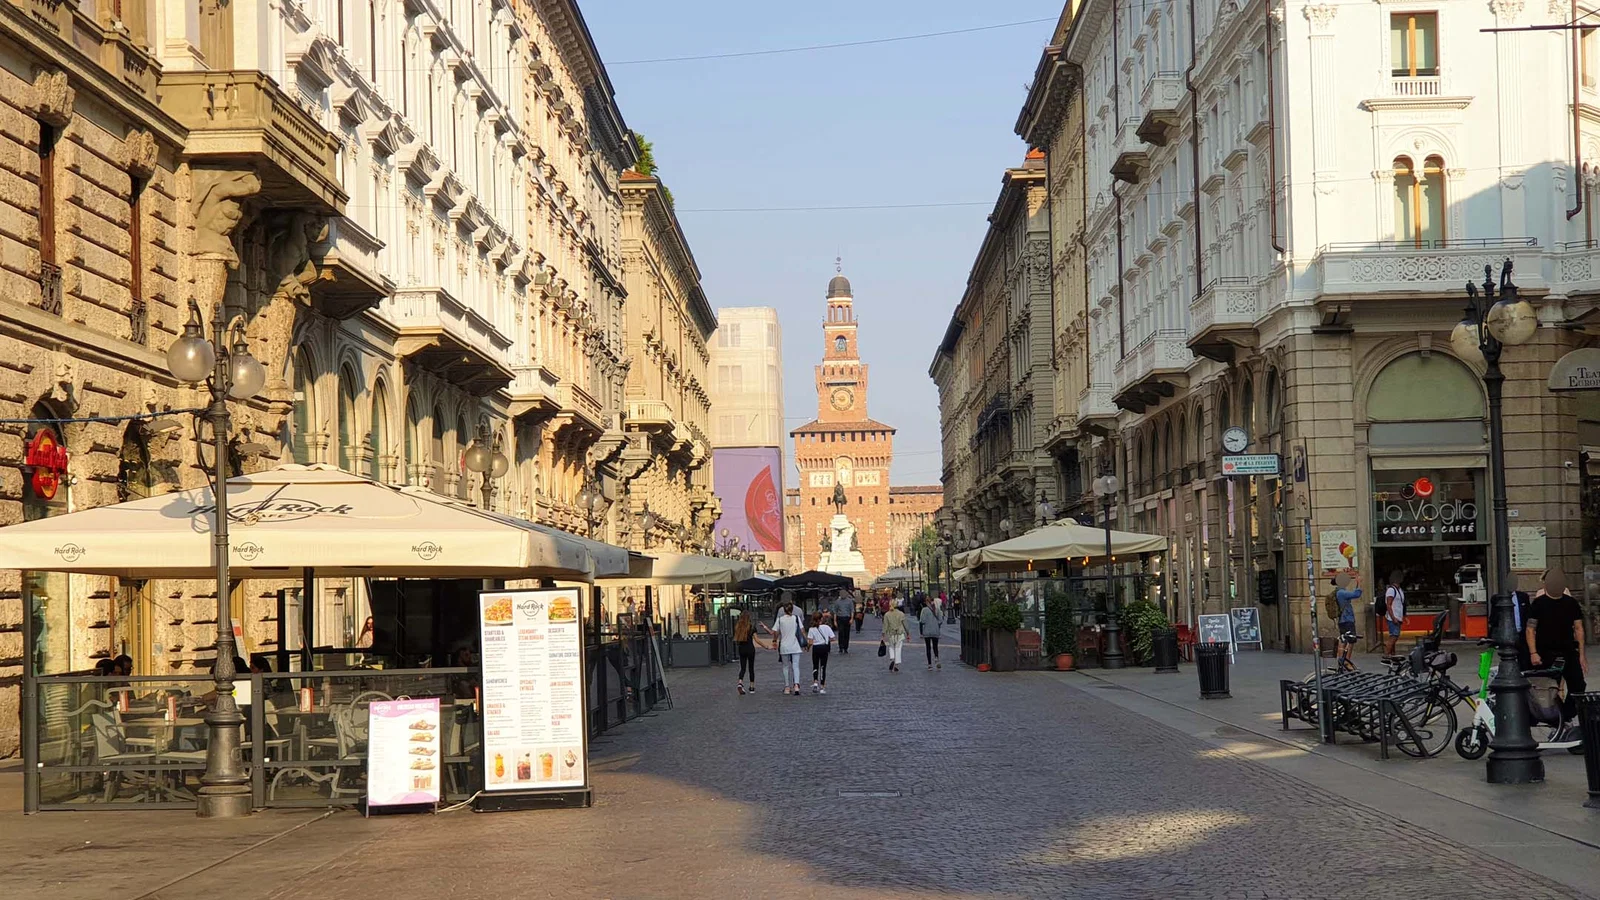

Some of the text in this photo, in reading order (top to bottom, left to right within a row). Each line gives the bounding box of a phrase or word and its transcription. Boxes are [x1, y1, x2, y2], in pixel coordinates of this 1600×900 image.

[187, 503, 353, 515] Hrd Rock
[1407, 498, 1478, 525] Voglia
[1382, 526, 1426, 534] GELATO
[1430, 525, 1436, 533] &
[54, 547, 86, 555] Hard Rock
[249, 545, 265, 554] Rock
[428, 545, 443, 554] Rock
